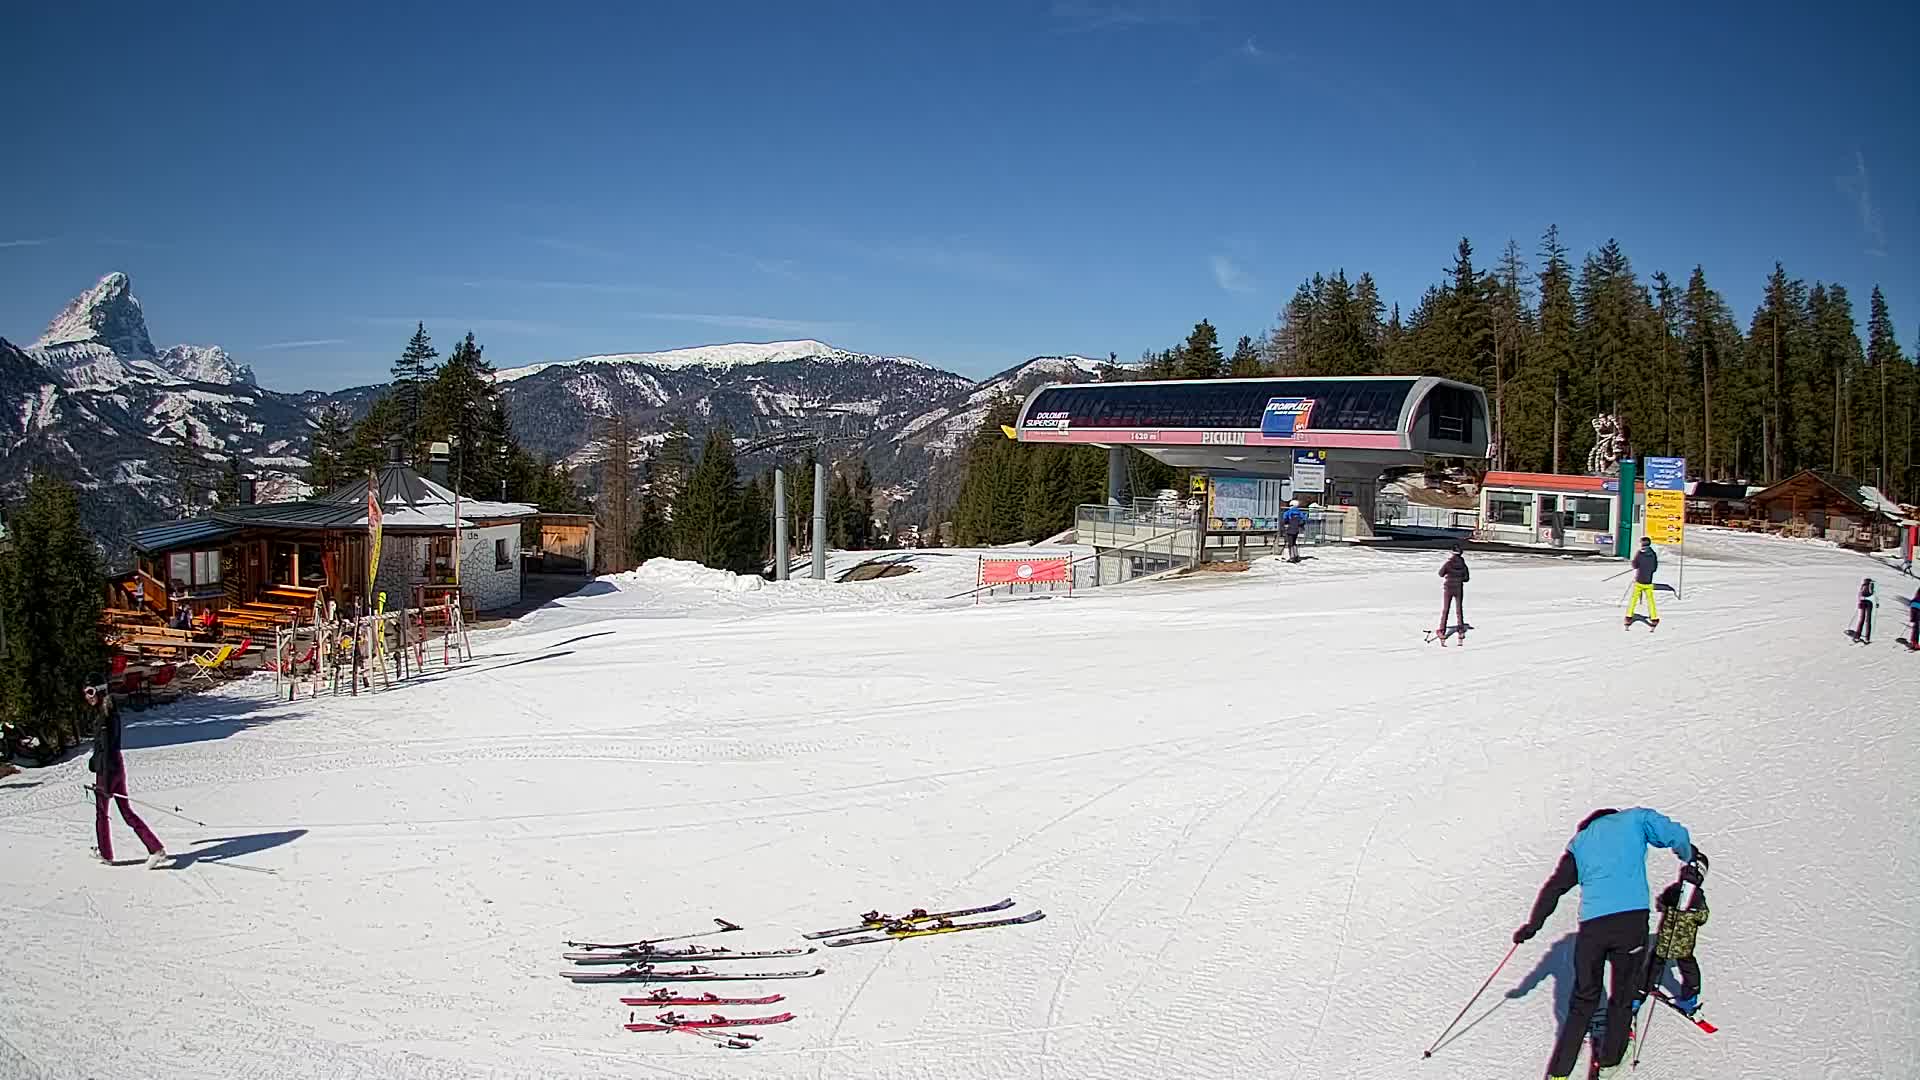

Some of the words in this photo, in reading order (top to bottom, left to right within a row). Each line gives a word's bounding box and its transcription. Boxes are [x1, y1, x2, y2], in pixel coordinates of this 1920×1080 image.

[1266, 402, 1312, 411] KRONPLATZ
[1036, 411, 1069, 419] DOLOMITI
[1025, 419, 1059, 427] SUPERSKI
[1130, 432, 1148, 440] 1620
[1201, 432, 1246, 445] PICULIN
